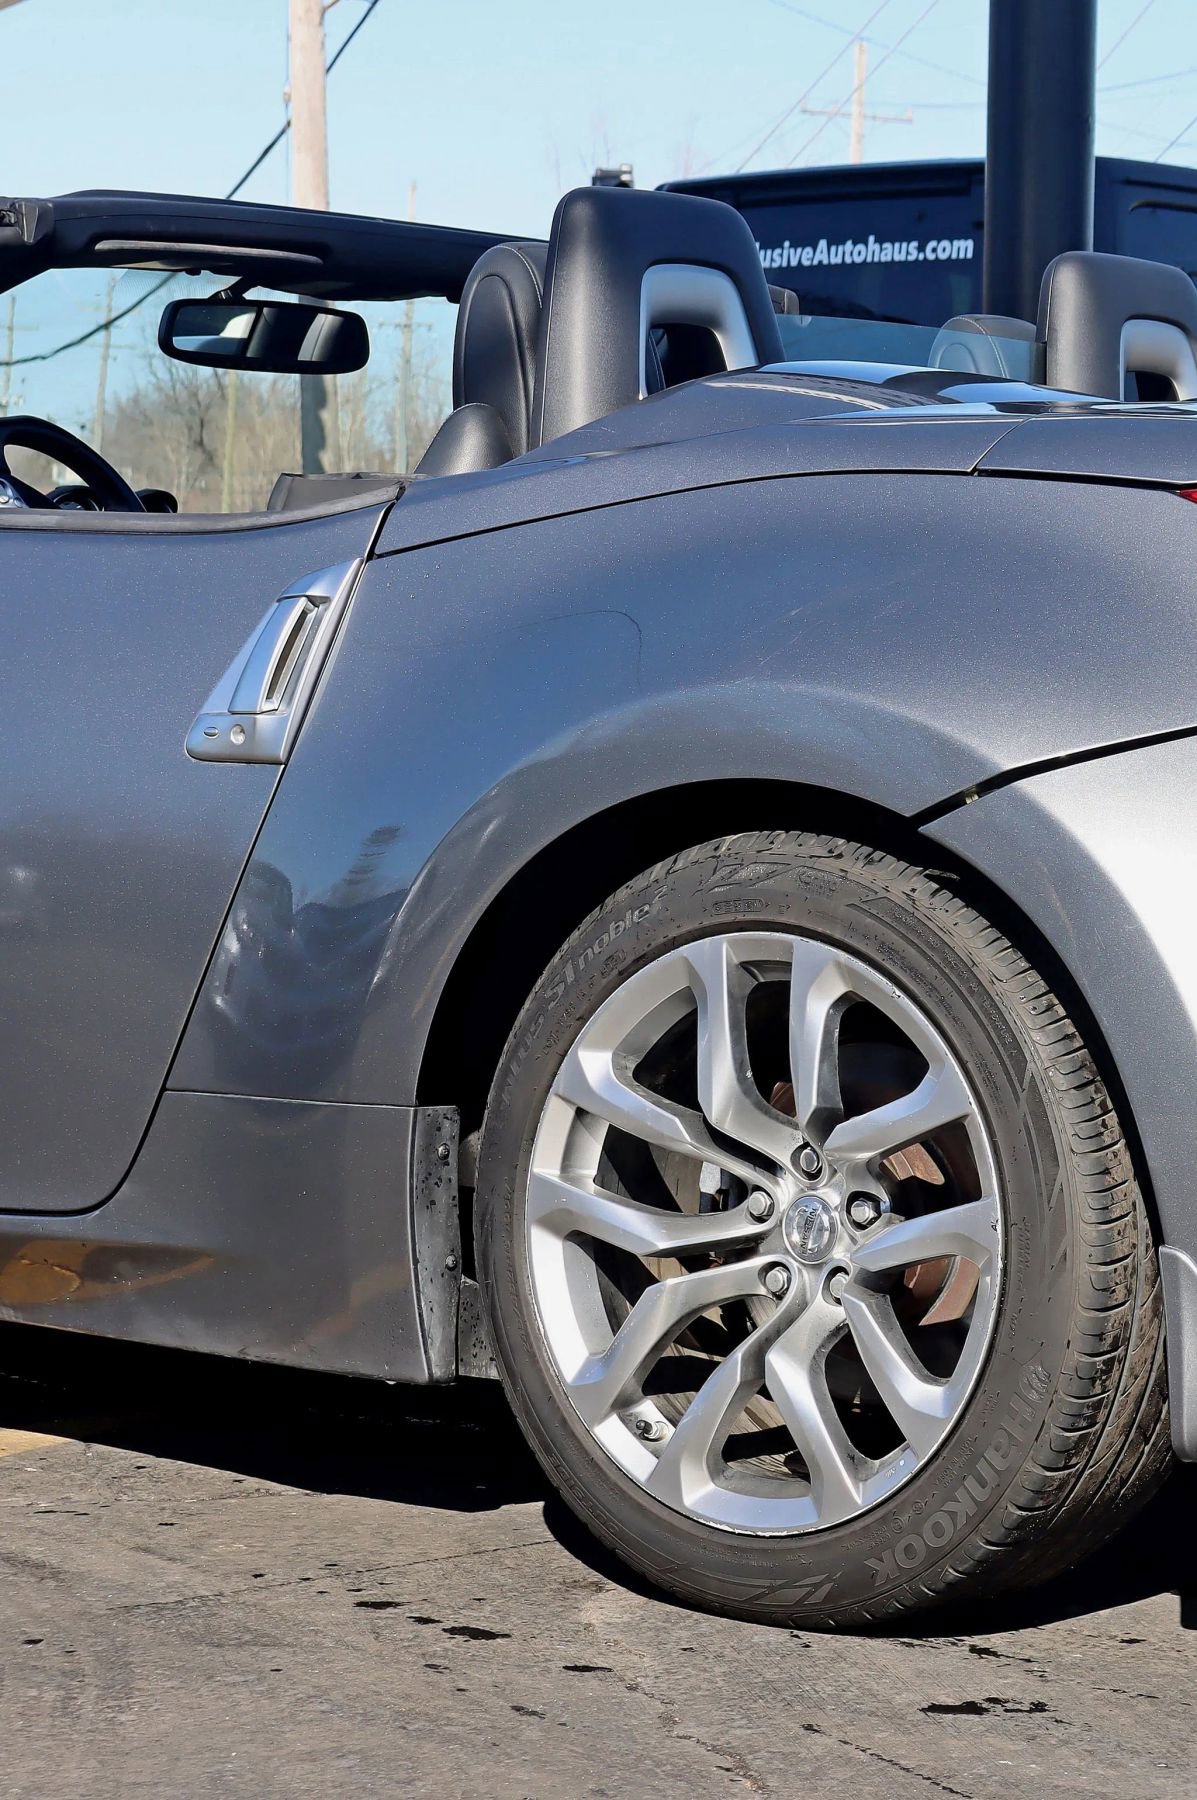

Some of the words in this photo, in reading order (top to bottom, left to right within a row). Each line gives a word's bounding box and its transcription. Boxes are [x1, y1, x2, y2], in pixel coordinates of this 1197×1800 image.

[756, 235, 974, 269] usiveAutohaus.com
[800, 1208, 818, 1250] NISSAN
[863, 1391, 1037, 1587] Hankook
